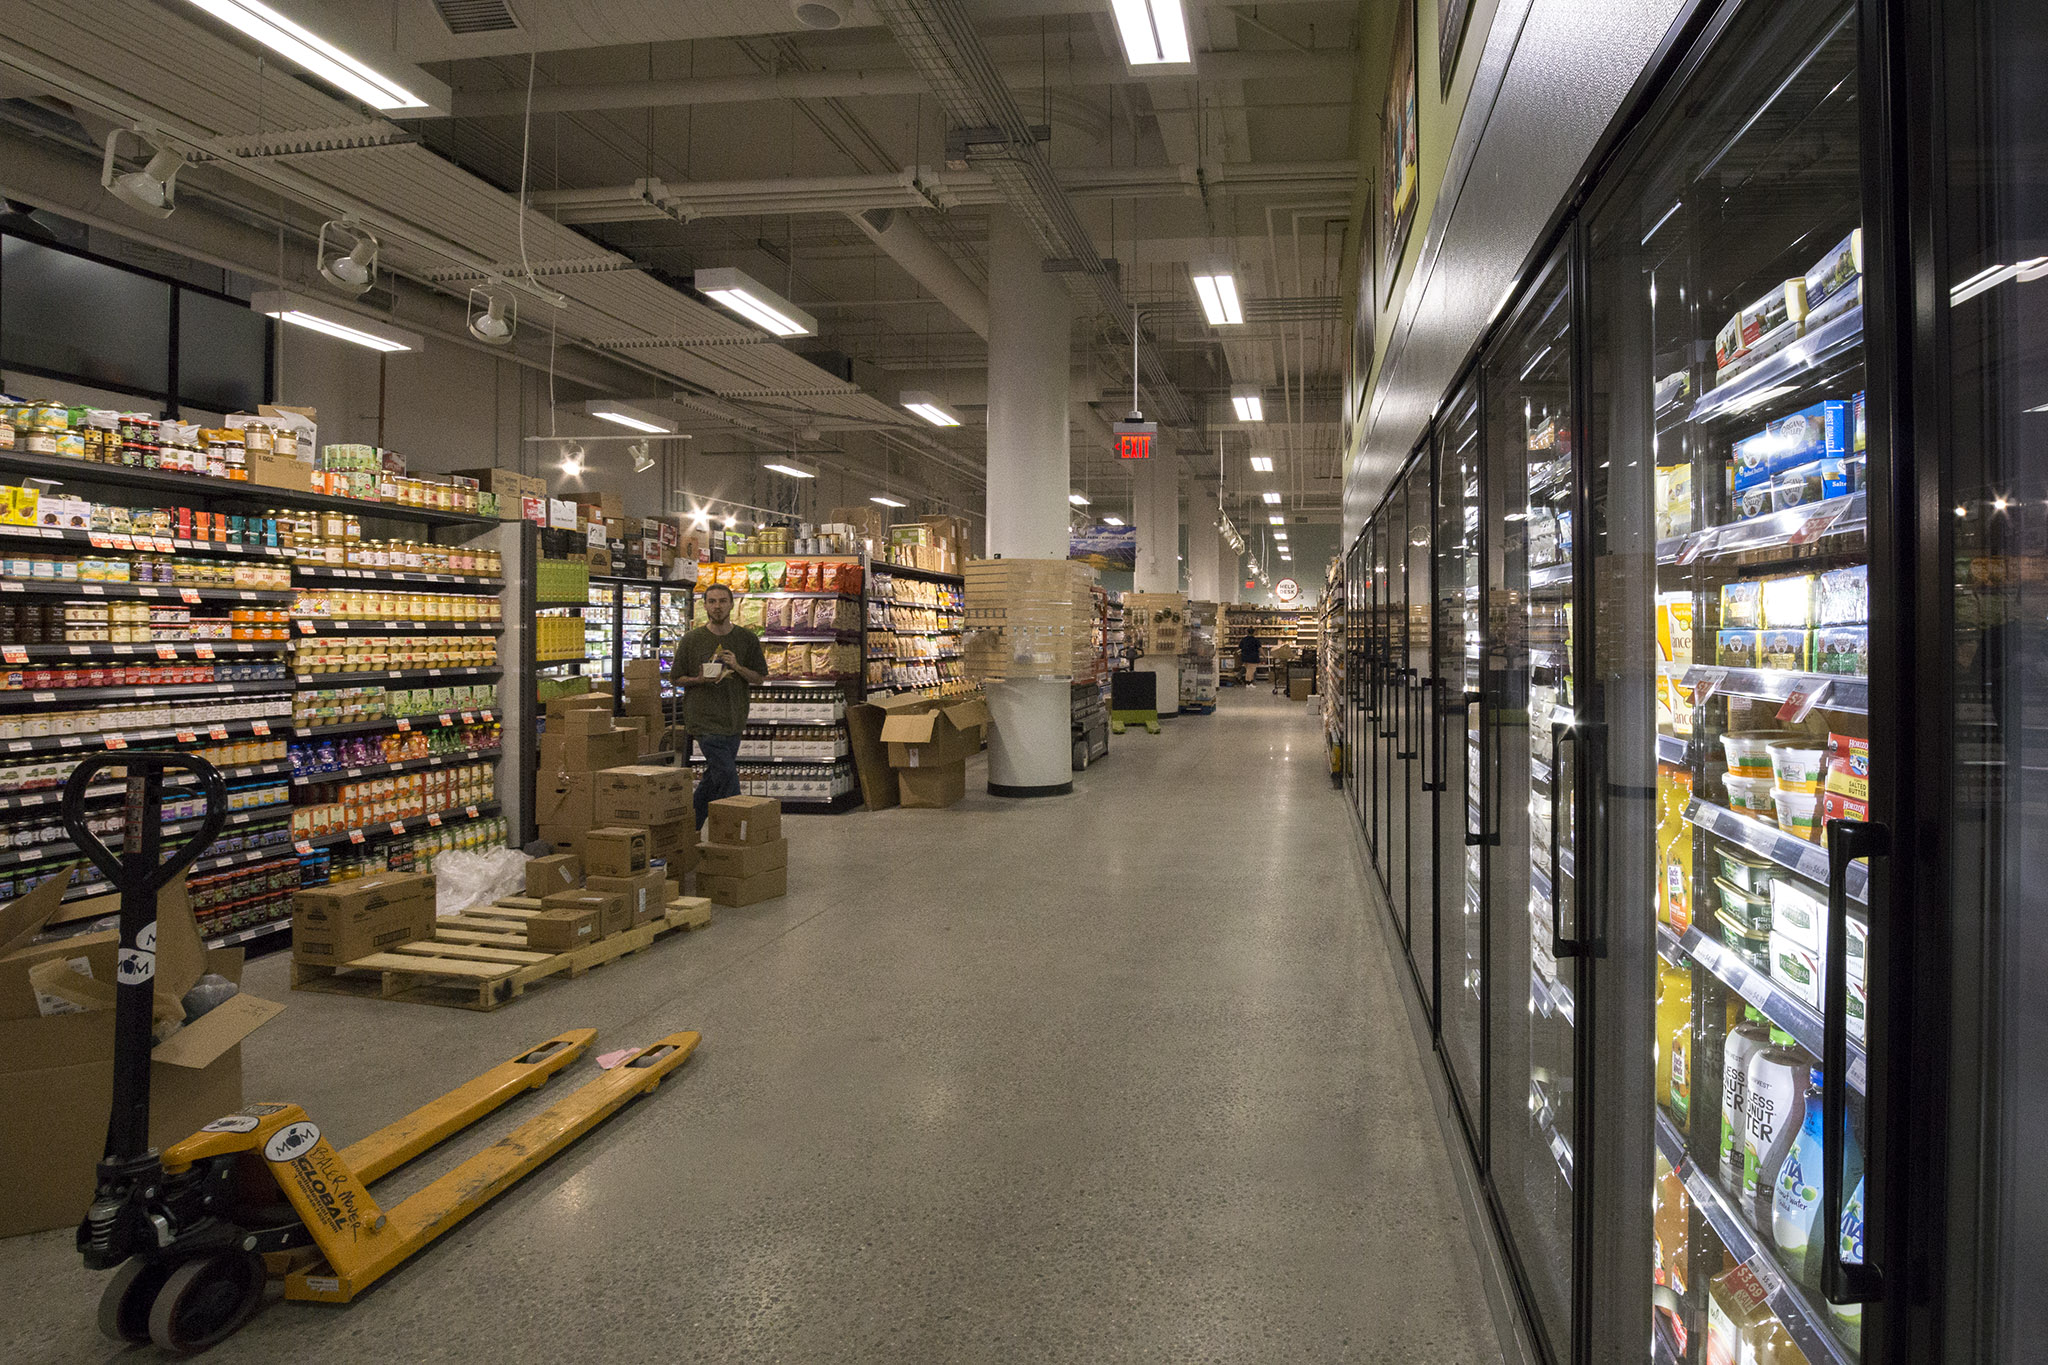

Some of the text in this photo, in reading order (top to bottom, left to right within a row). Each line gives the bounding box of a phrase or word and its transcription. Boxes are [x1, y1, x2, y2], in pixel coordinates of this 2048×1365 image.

[1826, 410, 1834, 425] FIRST
[1826, 426, 1835, 449] QUALITY
[1121, 435, 1151, 459] EXIT
[1848, 780, 1867, 791] SALTED
[1848, 787, 1867, 798] BUTTER
[1843, 800, 1866, 815] HORIZON
[1812, 864, 1828, 877] $6.49
[290, 1161, 338, 1233] globalindustrial.com
[297, 1156, 347, 1230] GLOBAL
[309, 1147, 361, 1243] BALER MOVER
[1789, 1197, 1808, 1211] water
[1737, 1267, 1764, 1298] $3.69
[1762, 1275, 1775, 1290] $5.49
